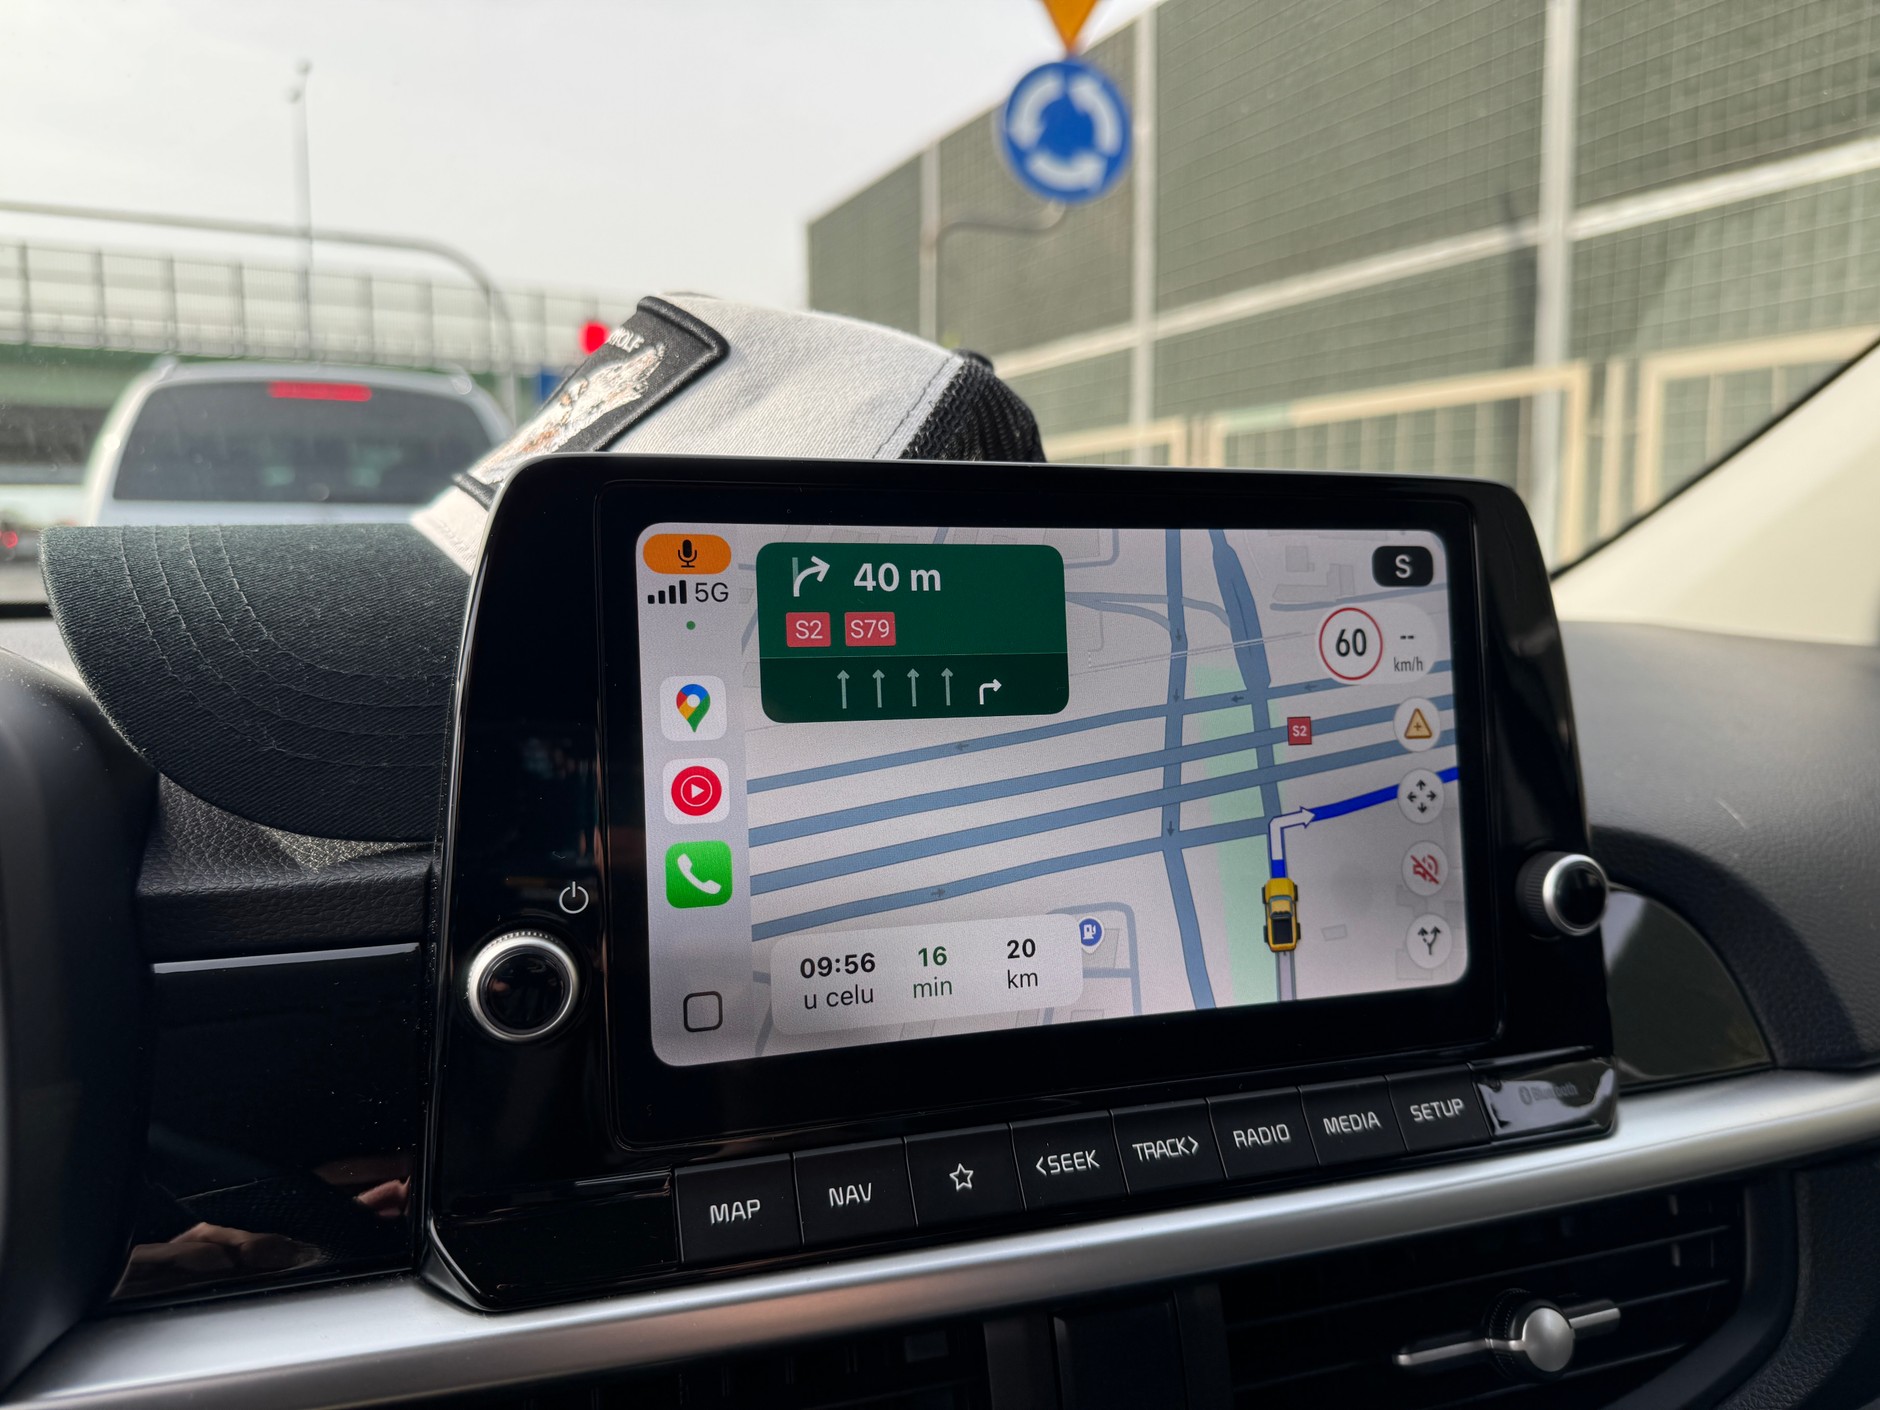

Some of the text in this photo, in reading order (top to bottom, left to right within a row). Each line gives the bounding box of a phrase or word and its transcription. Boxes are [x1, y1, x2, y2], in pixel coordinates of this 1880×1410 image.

[853, 562, 942, 592] 40 m
[1395, 554, 1412, 579] S
[695, 582, 729, 604] 5G
[795, 619, 823, 640] S2
[850, 618, 890, 639] S79
[1335, 627, 1367, 657] 60
[1393, 656, 1424, 672] km/h
[1292, 725, 1307, 737] S2
[917, 946, 948, 967] 16
[1006, 938, 1036, 959] 20
[799, 952, 876, 979] 09:56
[913, 976, 953, 999] min
[1006, 969, 1038, 989] km
[804, 984, 875, 1010] u celu
[1410, 1098, 1465, 1122] SETUP
[1322, 1111, 1381, 1135] MEDIA
[1233, 1123, 1290, 1149] RADIO
[828, 1182, 873, 1207] NAV
[710, 1198, 761, 1224] MAP
